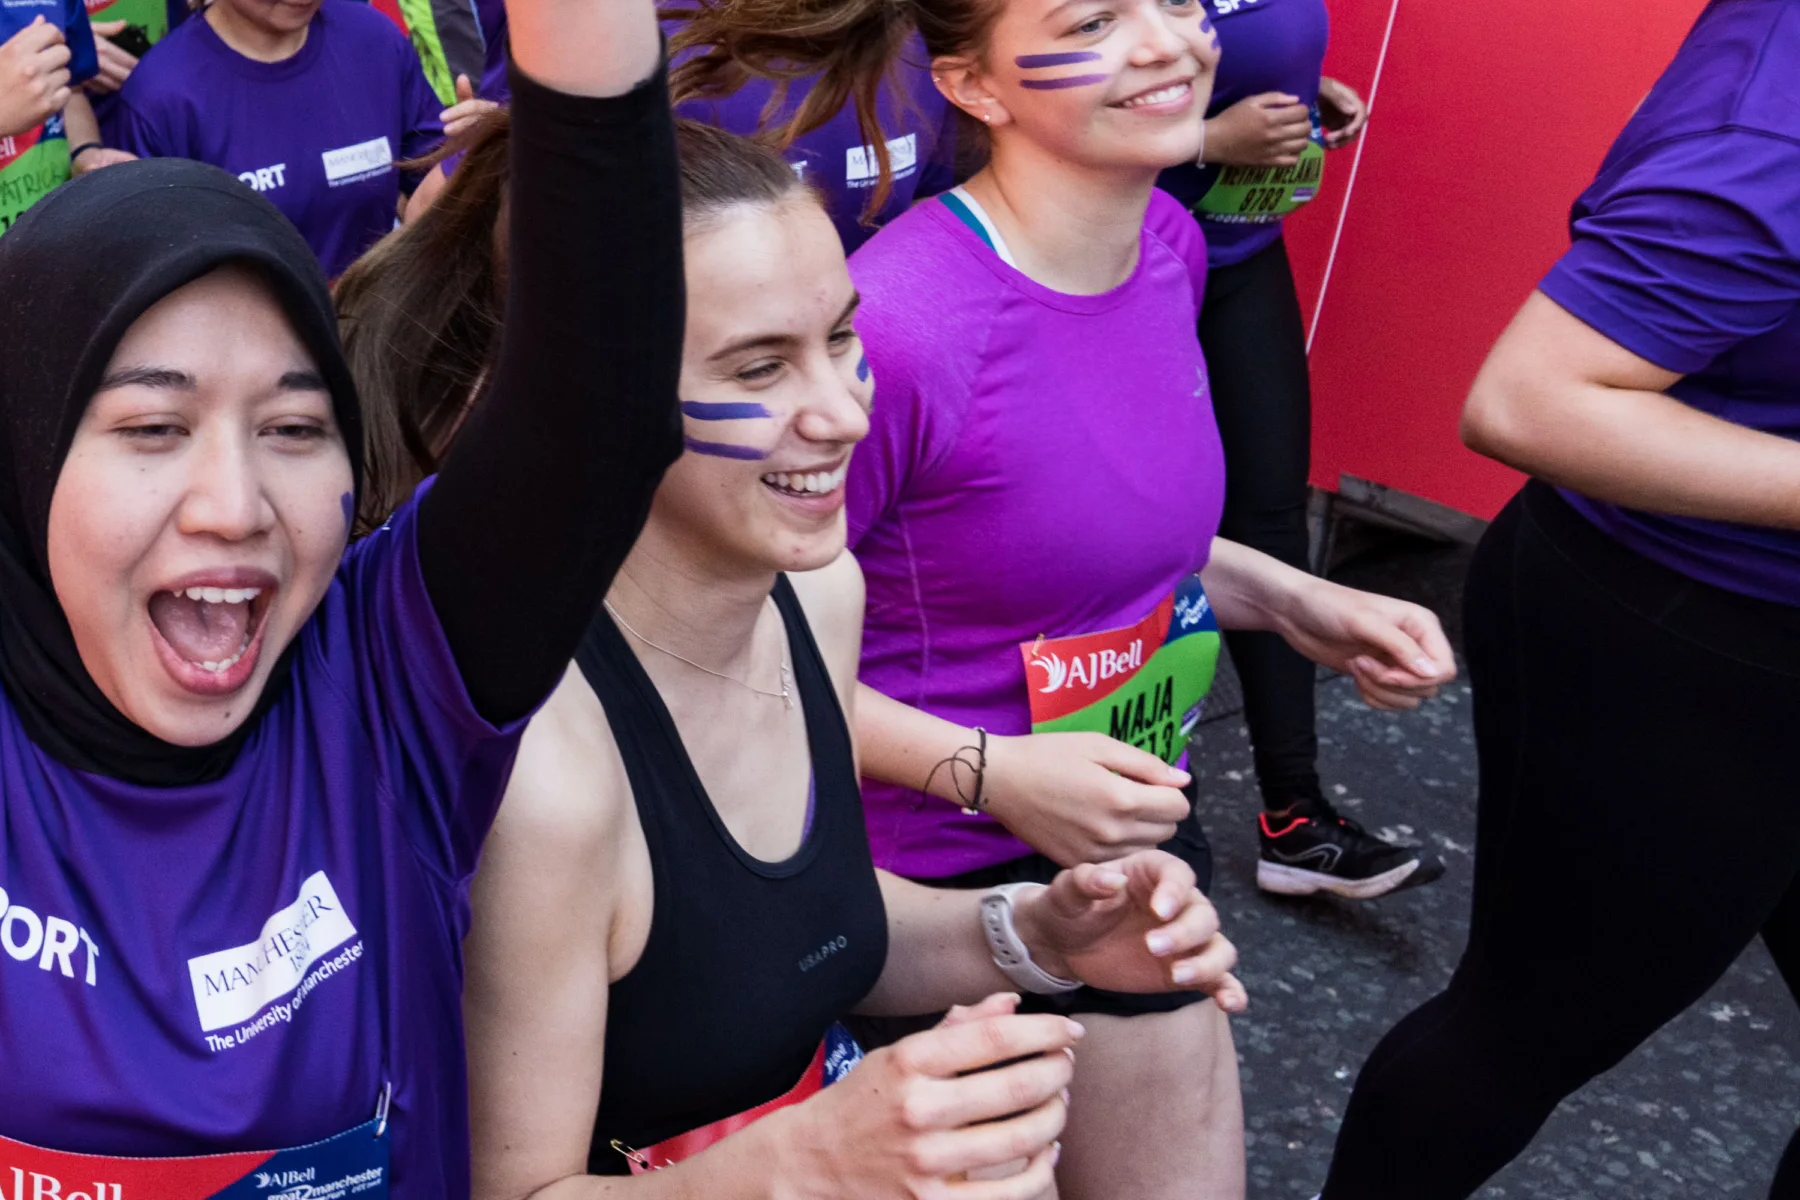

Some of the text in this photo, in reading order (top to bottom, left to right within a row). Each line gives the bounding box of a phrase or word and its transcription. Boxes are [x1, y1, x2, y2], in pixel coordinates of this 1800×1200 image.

[238, 162, 286, 192] ORT
[1066, 638, 1143, 690] AJBell
[1109, 675, 1173, 742] MAJA
[204, 895, 333, 996] MANHESER
[205, 1034, 235, 1052] The
[235, 1003, 292, 1043] University
